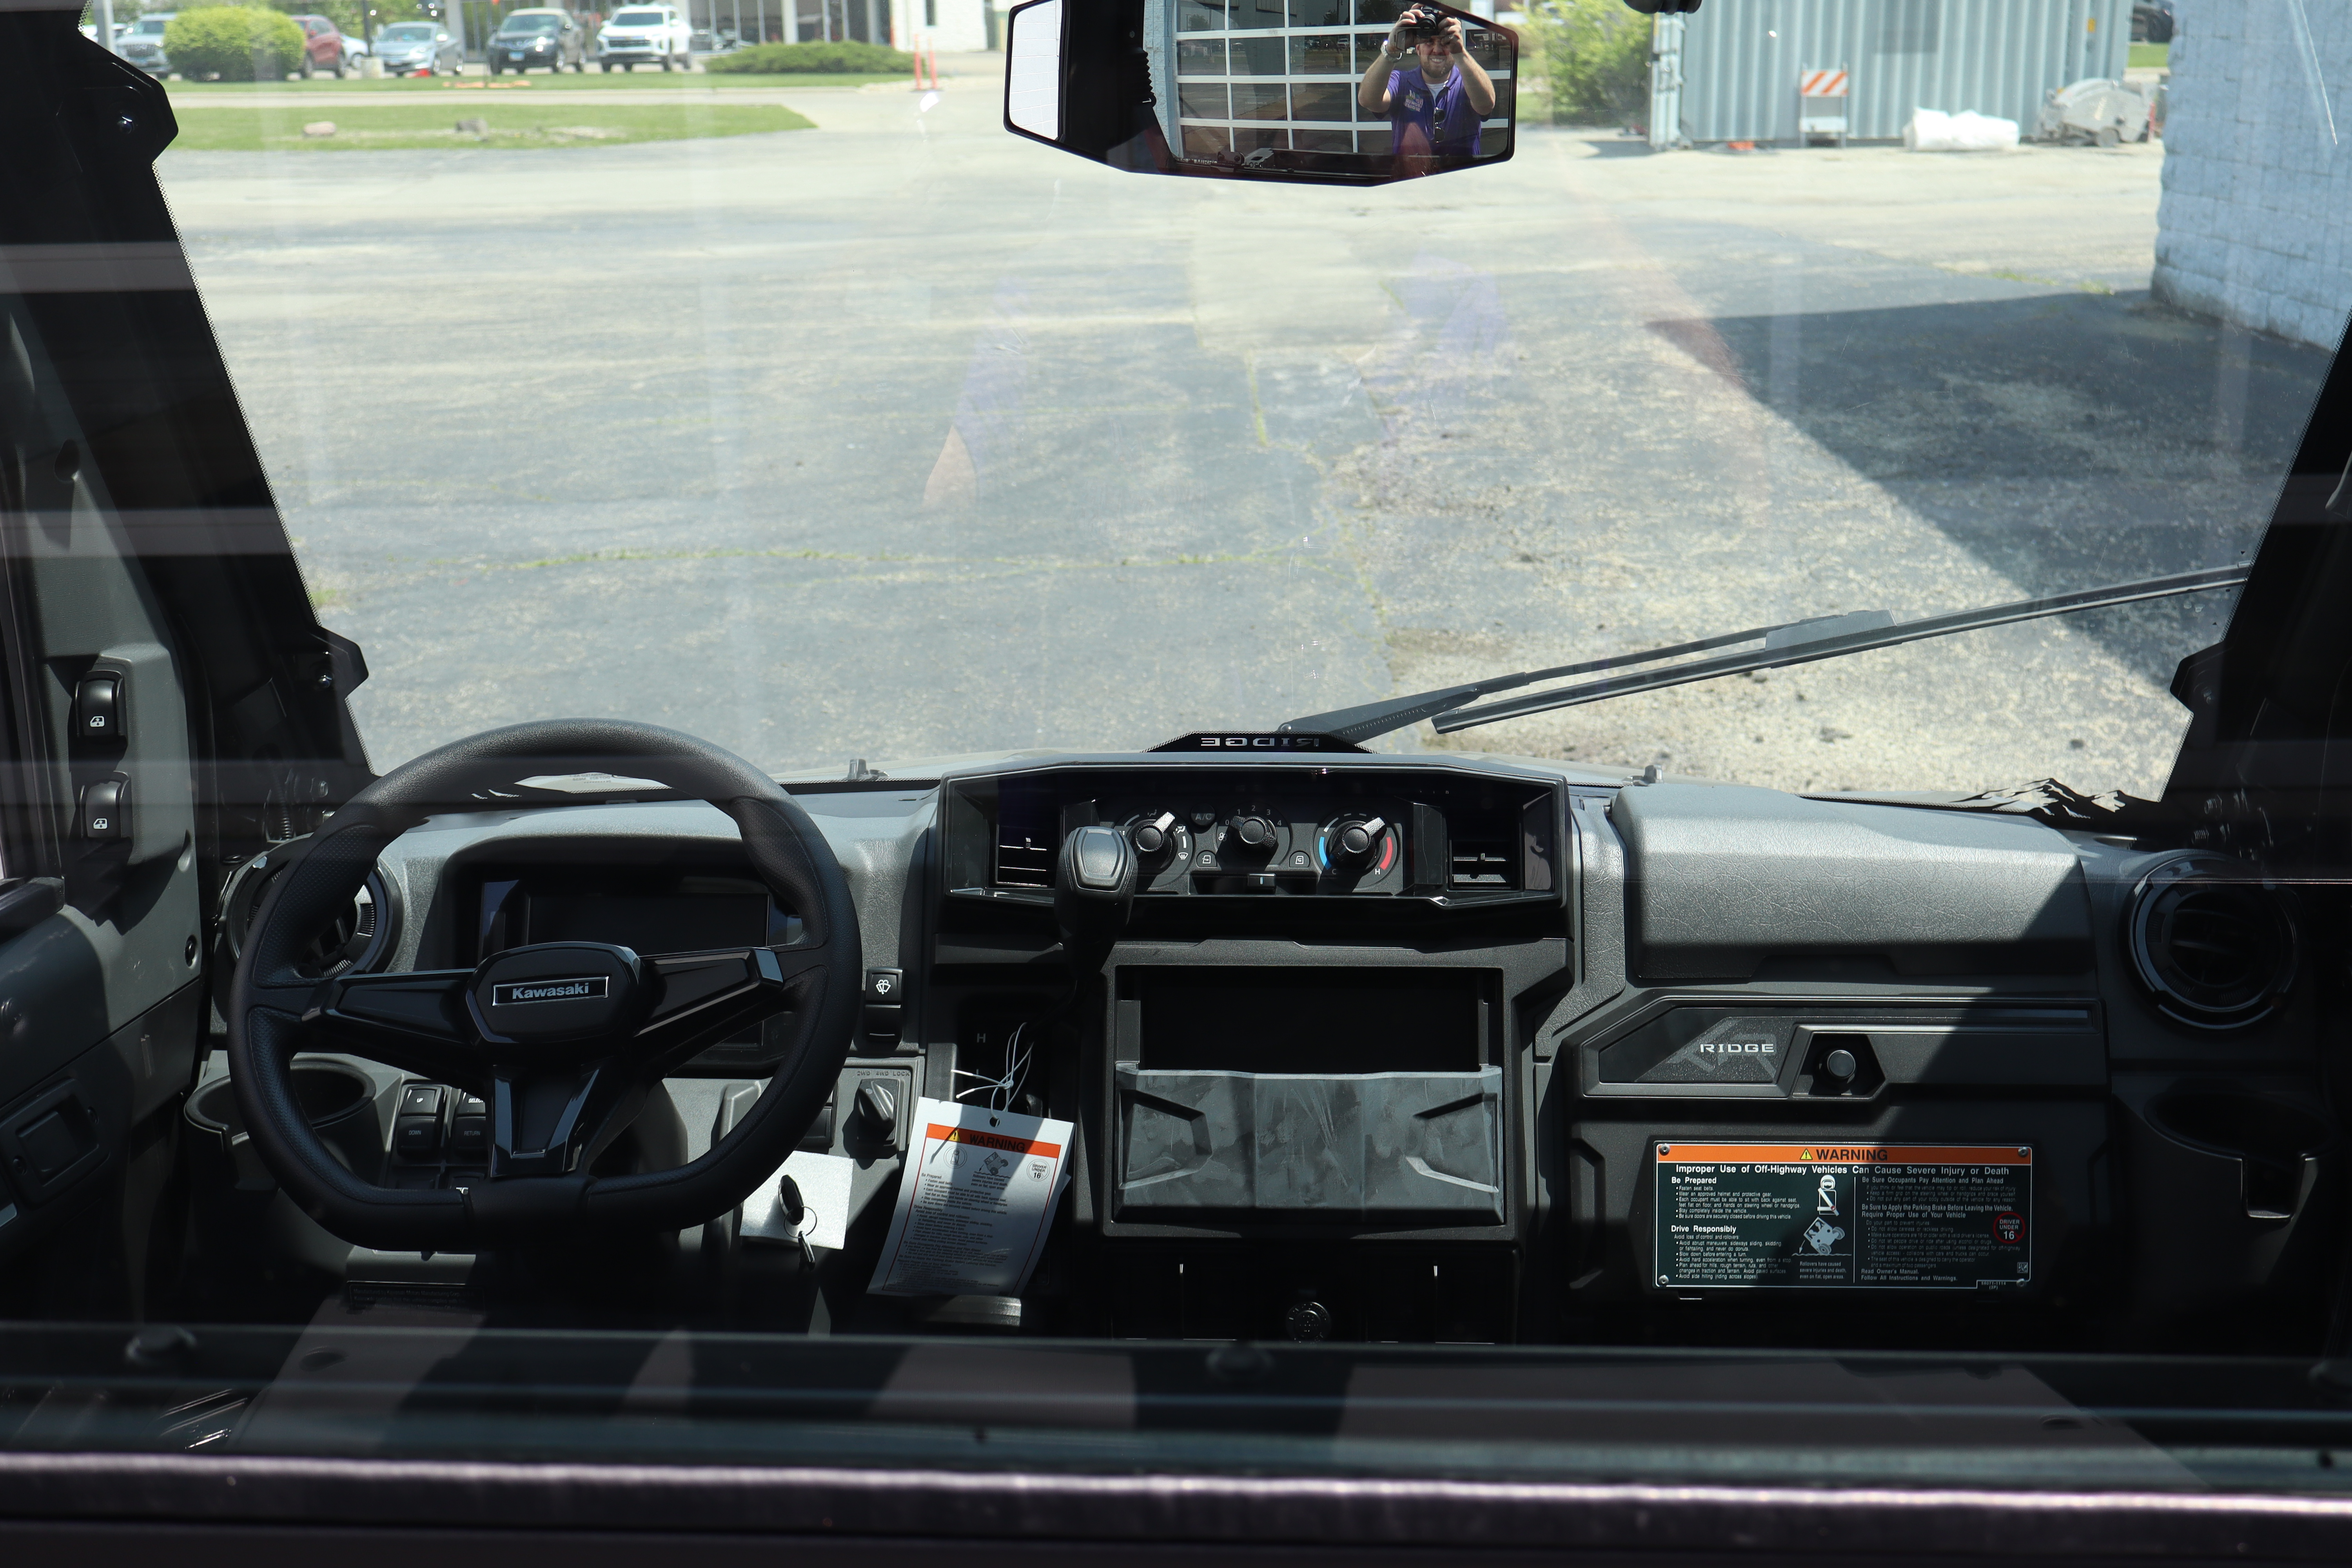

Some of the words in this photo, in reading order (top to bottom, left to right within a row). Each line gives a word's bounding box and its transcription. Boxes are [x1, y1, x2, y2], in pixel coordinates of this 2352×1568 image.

[512, 983, 589, 999] Kawasaki
[976, 1033, 986, 1043] H
[1700, 1044, 1774, 1053] RIDGE
[970, 1134, 1025, 1152] WARNING
[1816, 1149, 1888, 1161] WARNING
[1676, 1165, 1715, 1174] Improper
[1755, 1165, 1806, 1175] Off-Highway
[1852, 1165, 1869, 1174] Can
[1941, 1167, 1965, 1177] Injury
[1685, 1177, 1717, 1185] Prepared
[1693, 1225, 1737, 1234] Responsibly
[2004, 1231, 2014, 1239] 16
